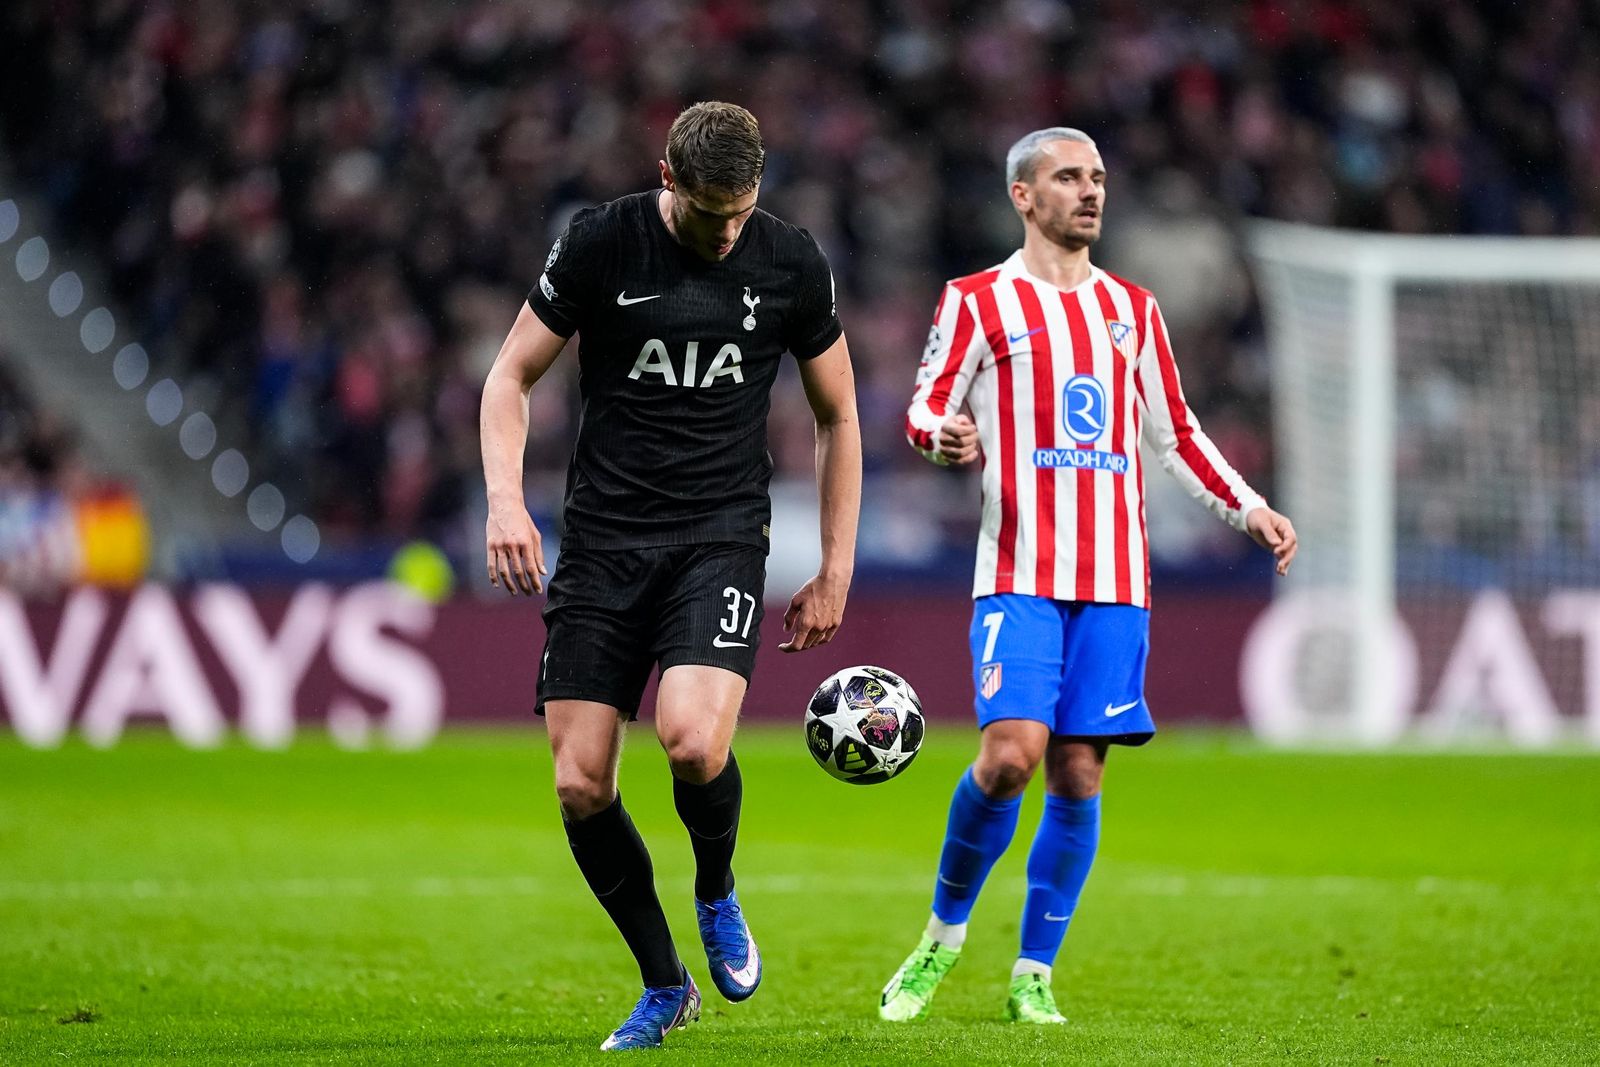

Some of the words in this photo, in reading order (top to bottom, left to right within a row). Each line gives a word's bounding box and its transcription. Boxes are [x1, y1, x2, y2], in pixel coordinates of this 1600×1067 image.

[627, 338, 745, 388] AIA
[1036, 449, 1101, 468] RIYADH
[1103, 455, 1127, 473] AIR
[720, 586, 756, 639] 37
[981, 611, 1006, 664] 7
